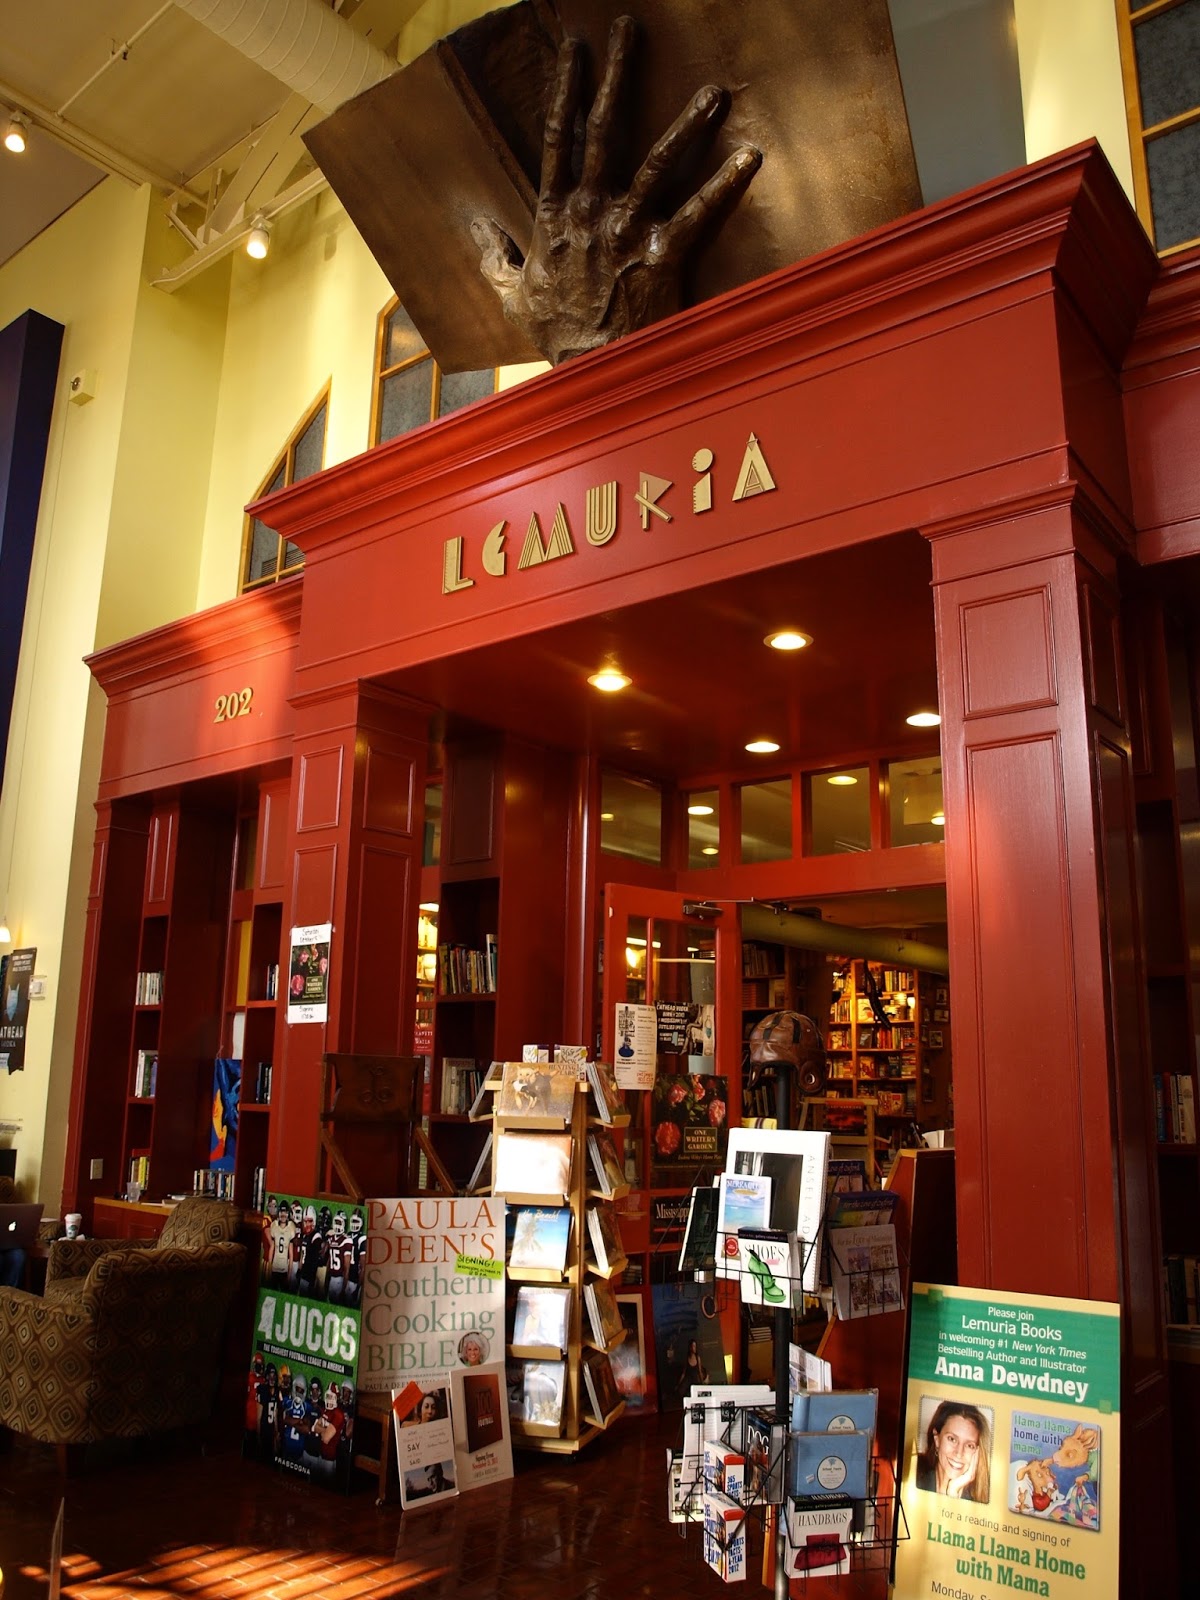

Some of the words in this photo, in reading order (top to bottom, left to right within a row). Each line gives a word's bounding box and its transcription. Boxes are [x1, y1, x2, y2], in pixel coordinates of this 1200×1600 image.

[213, 687, 253, 724] 202
[366, 1199, 497, 1230] PAULA
[279, 1237, 284, 1253] 6
[366, 1232, 495, 1265] DEEN'S
[329, 1249, 341, 1271] 15
[457, 1254, 495, 1268] SIGNING!
[365, 1266, 493, 1299] Southern
[365, 1300, 496, 1341] Cooking
[988, 1306, 1016, 1319] Please
[1016, 1310, 1034, 1322] join
[962, 1315, 1016, 1335] Lemuria
[1020, 1322, 1062, 1341] Books
[365, 1340, 457, 1373] BIBLE
[939, 1331, 947, 1340] in
[949, 1332, 995, 1349] welcoming
[998, 1339, 1009, 1348] #1
[1012, 1340, 1033, 1352] New
[1035, 1344, 1056, 1355] York
[1058, 1346, 1087, 1360] Times
[289, 1350, 307, 1362] FOOTBALL
[307, 1356, 322, 1367] LEAGUE
[327, 1361, 345, 1373] AMERICA
[938, 1343, 984, 1360] Bestselling
[986, 1350, 1017, 1363] Author
[1020, 1355, 1037, 1366] and
[1040, 1358, 1087, 1374] Illustrator
[935, 1356, 984, 1382] Anna
[991, 1364, 1089, 1403] Dewdney
[1014, 1415, 1041, 1429] llama
[1044, 1421, 1072, 1434] llama
[1014, 1427, 1039, 1442] home
[1041, 1433, 1063, 1446] with
[407, 1442, 421, 1452] SAY
[1013, 1442, 1042, 1455] mama
[274, 1456, 311, 1475] FRASCOGNA
[409, 1458, 421, 1466] SAID
[727, 1480, 742, 1492] SPORTS
[798, 1512, 848, 1527] HANDBAGS
[942, 1508, 954, 1519] for
[956, 1512, 962, 1521] a
[965, 1514, 999, 1532] reading
[1002, 1522, 1020, 1535] and
[1022, 1528, 1057, 1547] signing
[1060, 1538, 1071, 1548] of
[927, 1521, 976, 1552] Llama
[980, 1534, 1031, 1566] Llama
[1035, 1547, 1086, 1580] Home
[956, 1556, 992, 1581] with
[996, 1564, 1050, 1597] Mama
